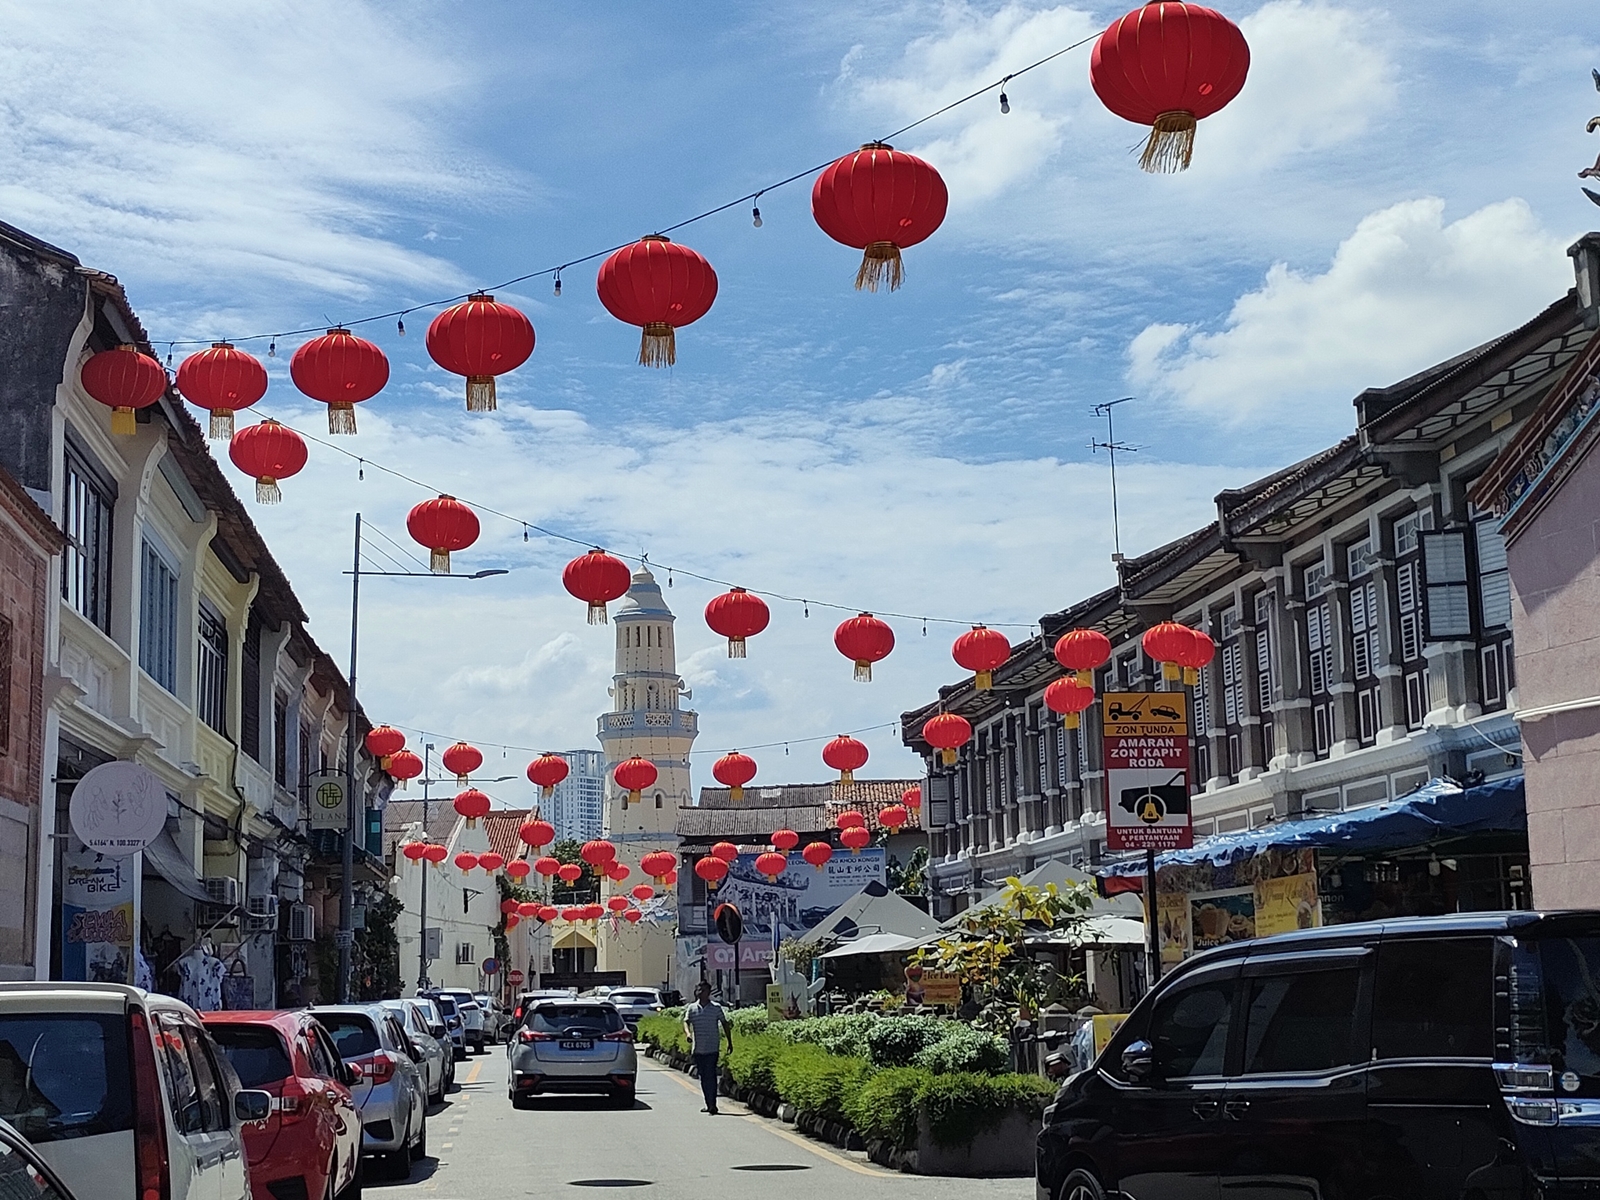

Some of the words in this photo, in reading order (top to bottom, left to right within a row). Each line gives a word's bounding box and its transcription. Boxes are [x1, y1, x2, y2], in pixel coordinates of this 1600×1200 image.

[1115, 725, 1137, 734] ZON
[1140, 725, 1176, 734] TUNDA
[1118, 738, 1174, 748] AMARAN
[1110, 748, 1138, 758] ZON
[1142, 748, 1182, 757] KAPIT
[1129, 758, 1165, 768] RODA
[312, 812, 346, 820] CLANS
[87, 884, 118, 893] BIKE
[1196, 938, 1220, 947] Juice
